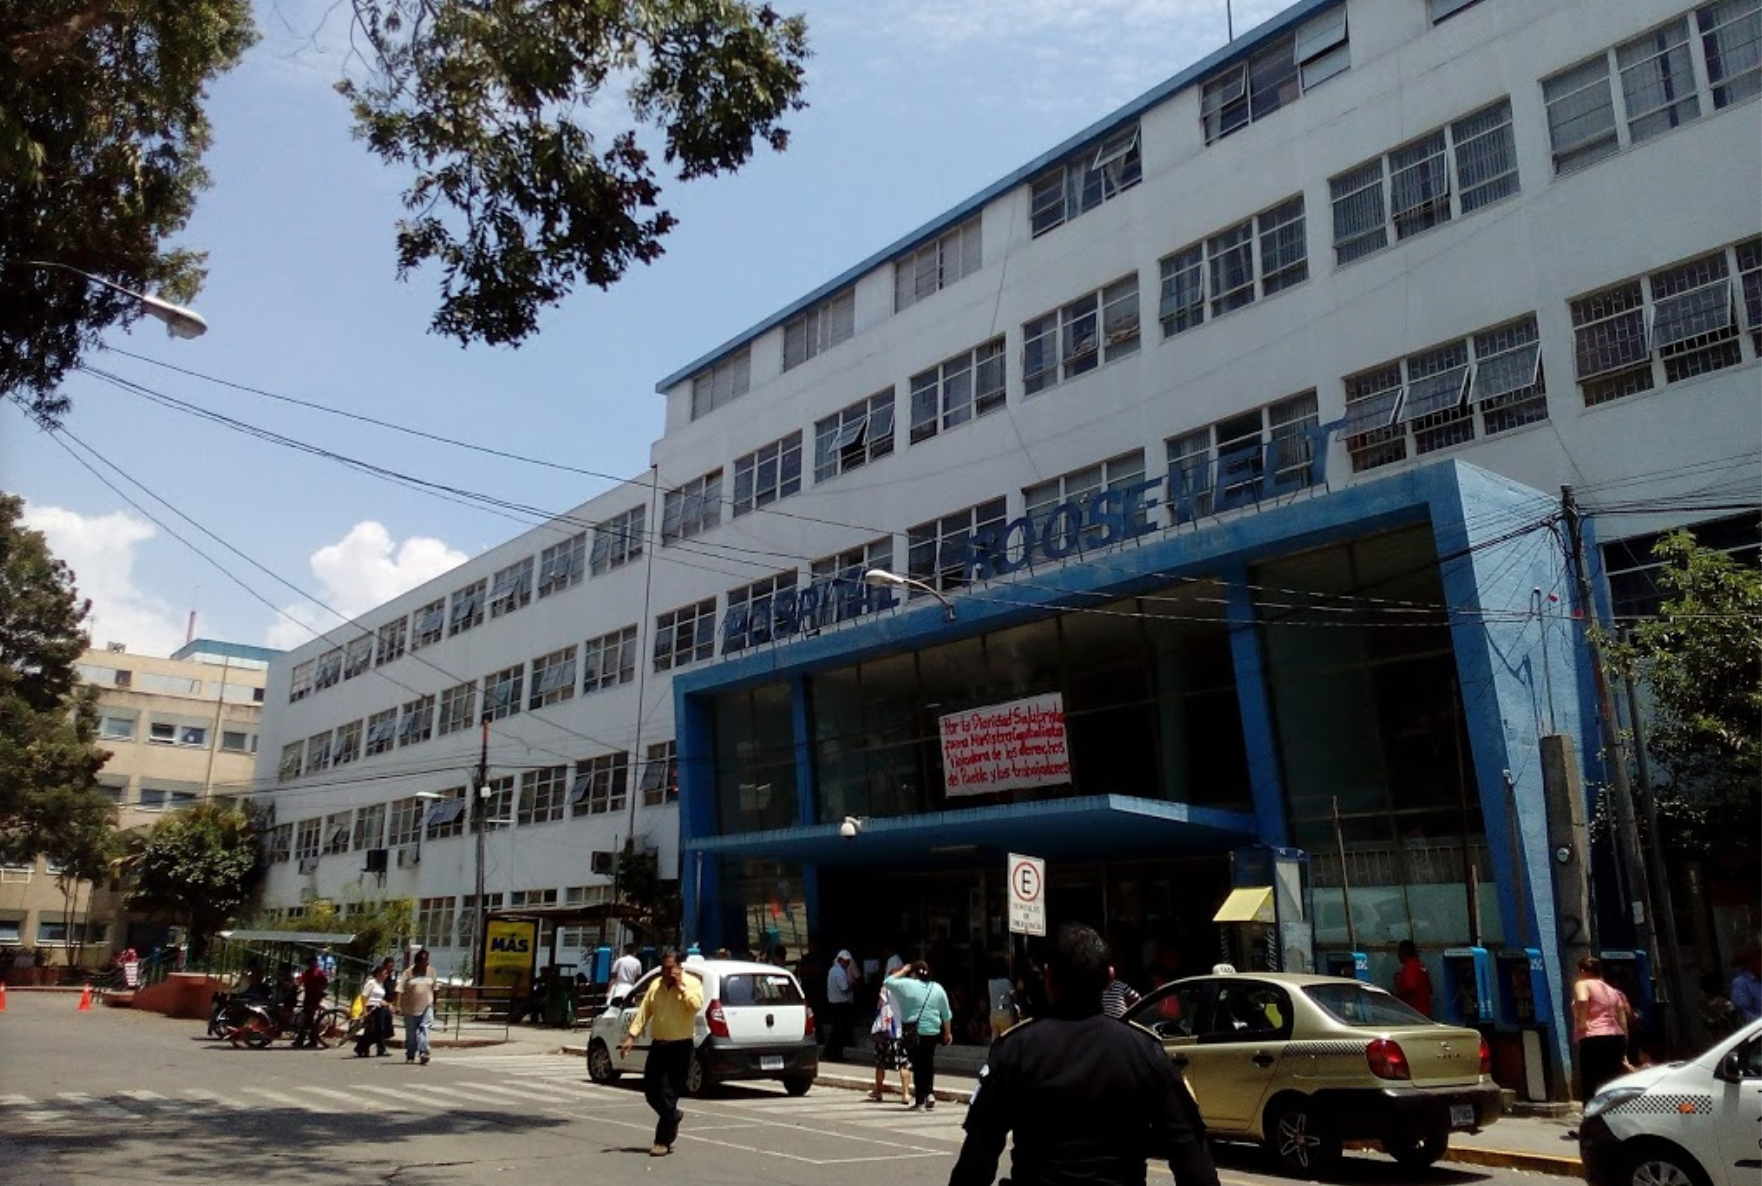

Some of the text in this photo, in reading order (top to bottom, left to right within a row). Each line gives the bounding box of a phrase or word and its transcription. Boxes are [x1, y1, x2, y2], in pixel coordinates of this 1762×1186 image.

[721, 417, 1350, 656] HOSPITAL ROOSEVELT
[943, 717, 958, 735] Por
[991, 746, 1002, 760] de
[1005, 743, 1018, 760] los
[1019, 739, 1065, 757] derechos
[1021, 869, 1031, 895] E
[491, 933, 529, 952] MÁS
